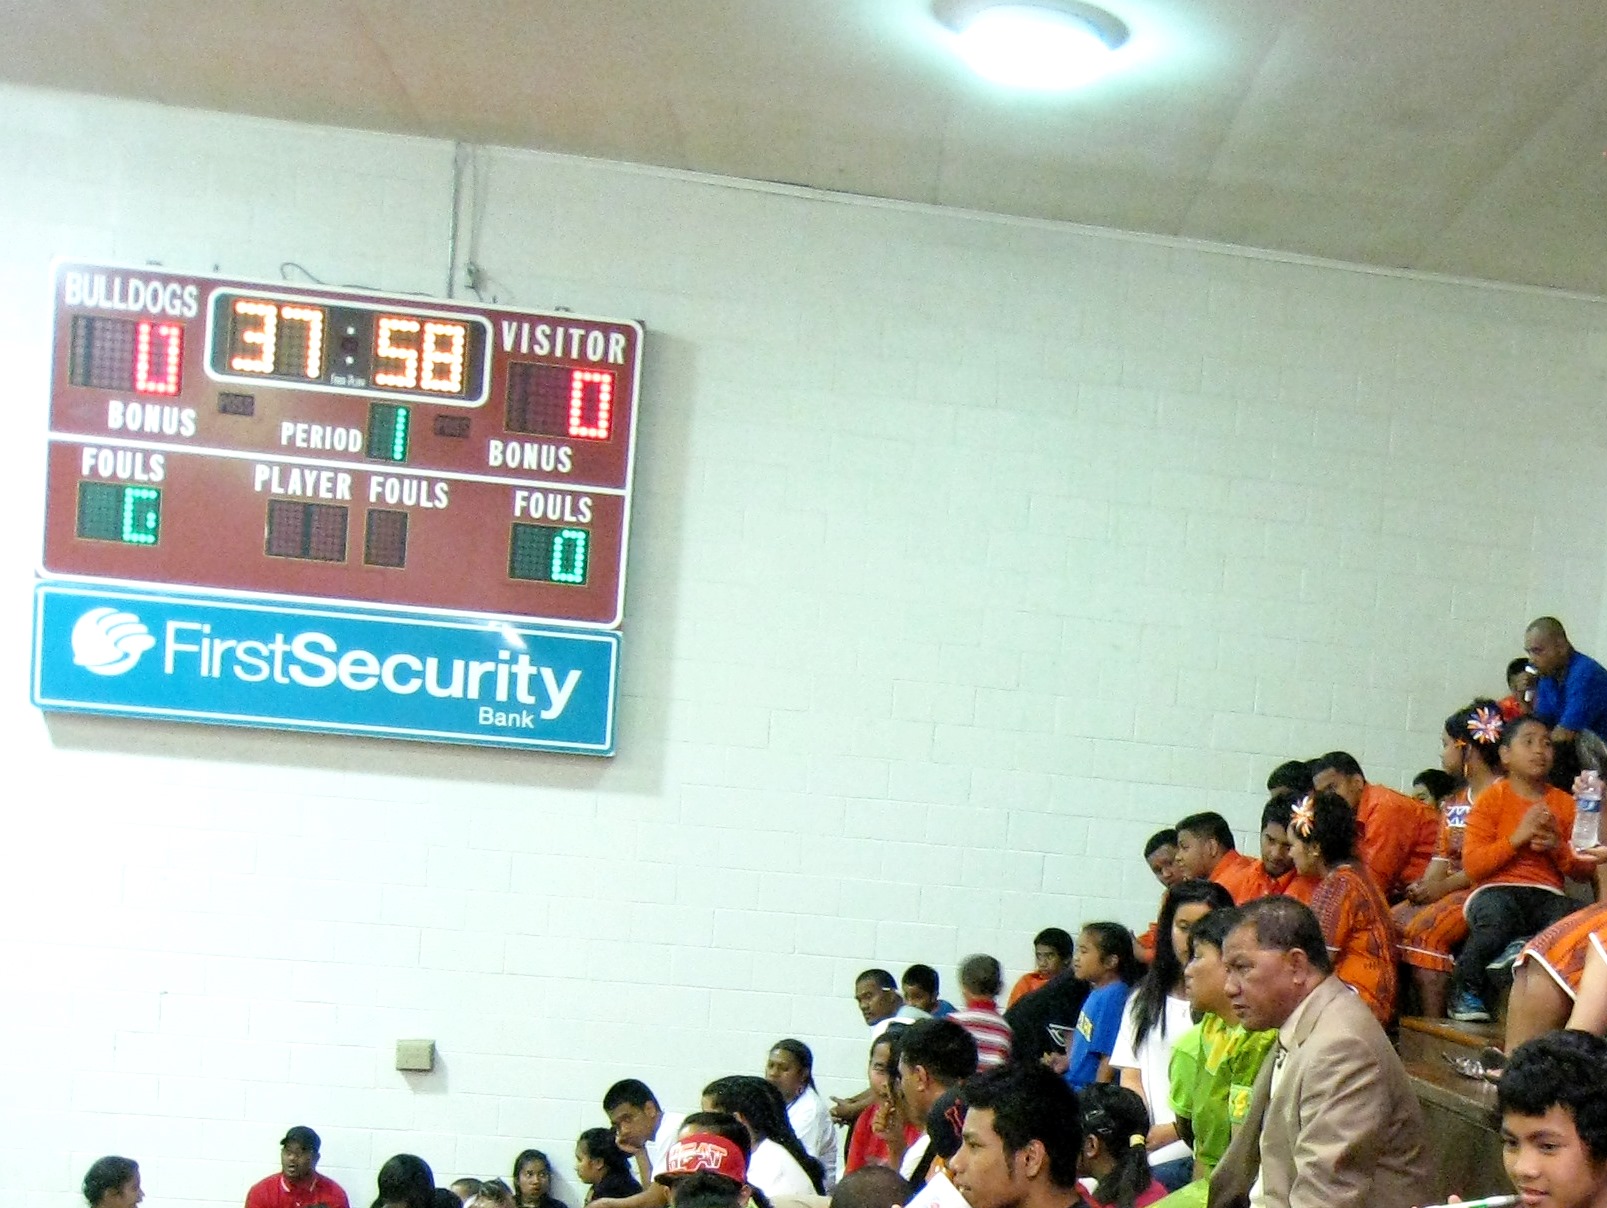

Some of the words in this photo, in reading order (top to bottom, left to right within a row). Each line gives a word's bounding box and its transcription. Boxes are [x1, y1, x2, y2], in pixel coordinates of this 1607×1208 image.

[65, 272, 198, 318] BULLDOGS
[501, 319, 627, 365] VISITOR
[107, 399, 198, 437] BONUS
[567, 368, 614, 440] 0
[280, 421, 363, 452] PERIOD
[391, 405, 408, 461] 1
[81, 447, 166, 482] FOULS
[488, 438, 574, 474] BONUS
[254, 464, 352, 500] PLAYER
[369, 475, 449, 509] FOULS
[514, 490, 593, 524] FOULS
[551, 528, 586, 583] 0
[164, 620, 582, 720] FirstSecurity
[478, 706, 535, 729] Bank
